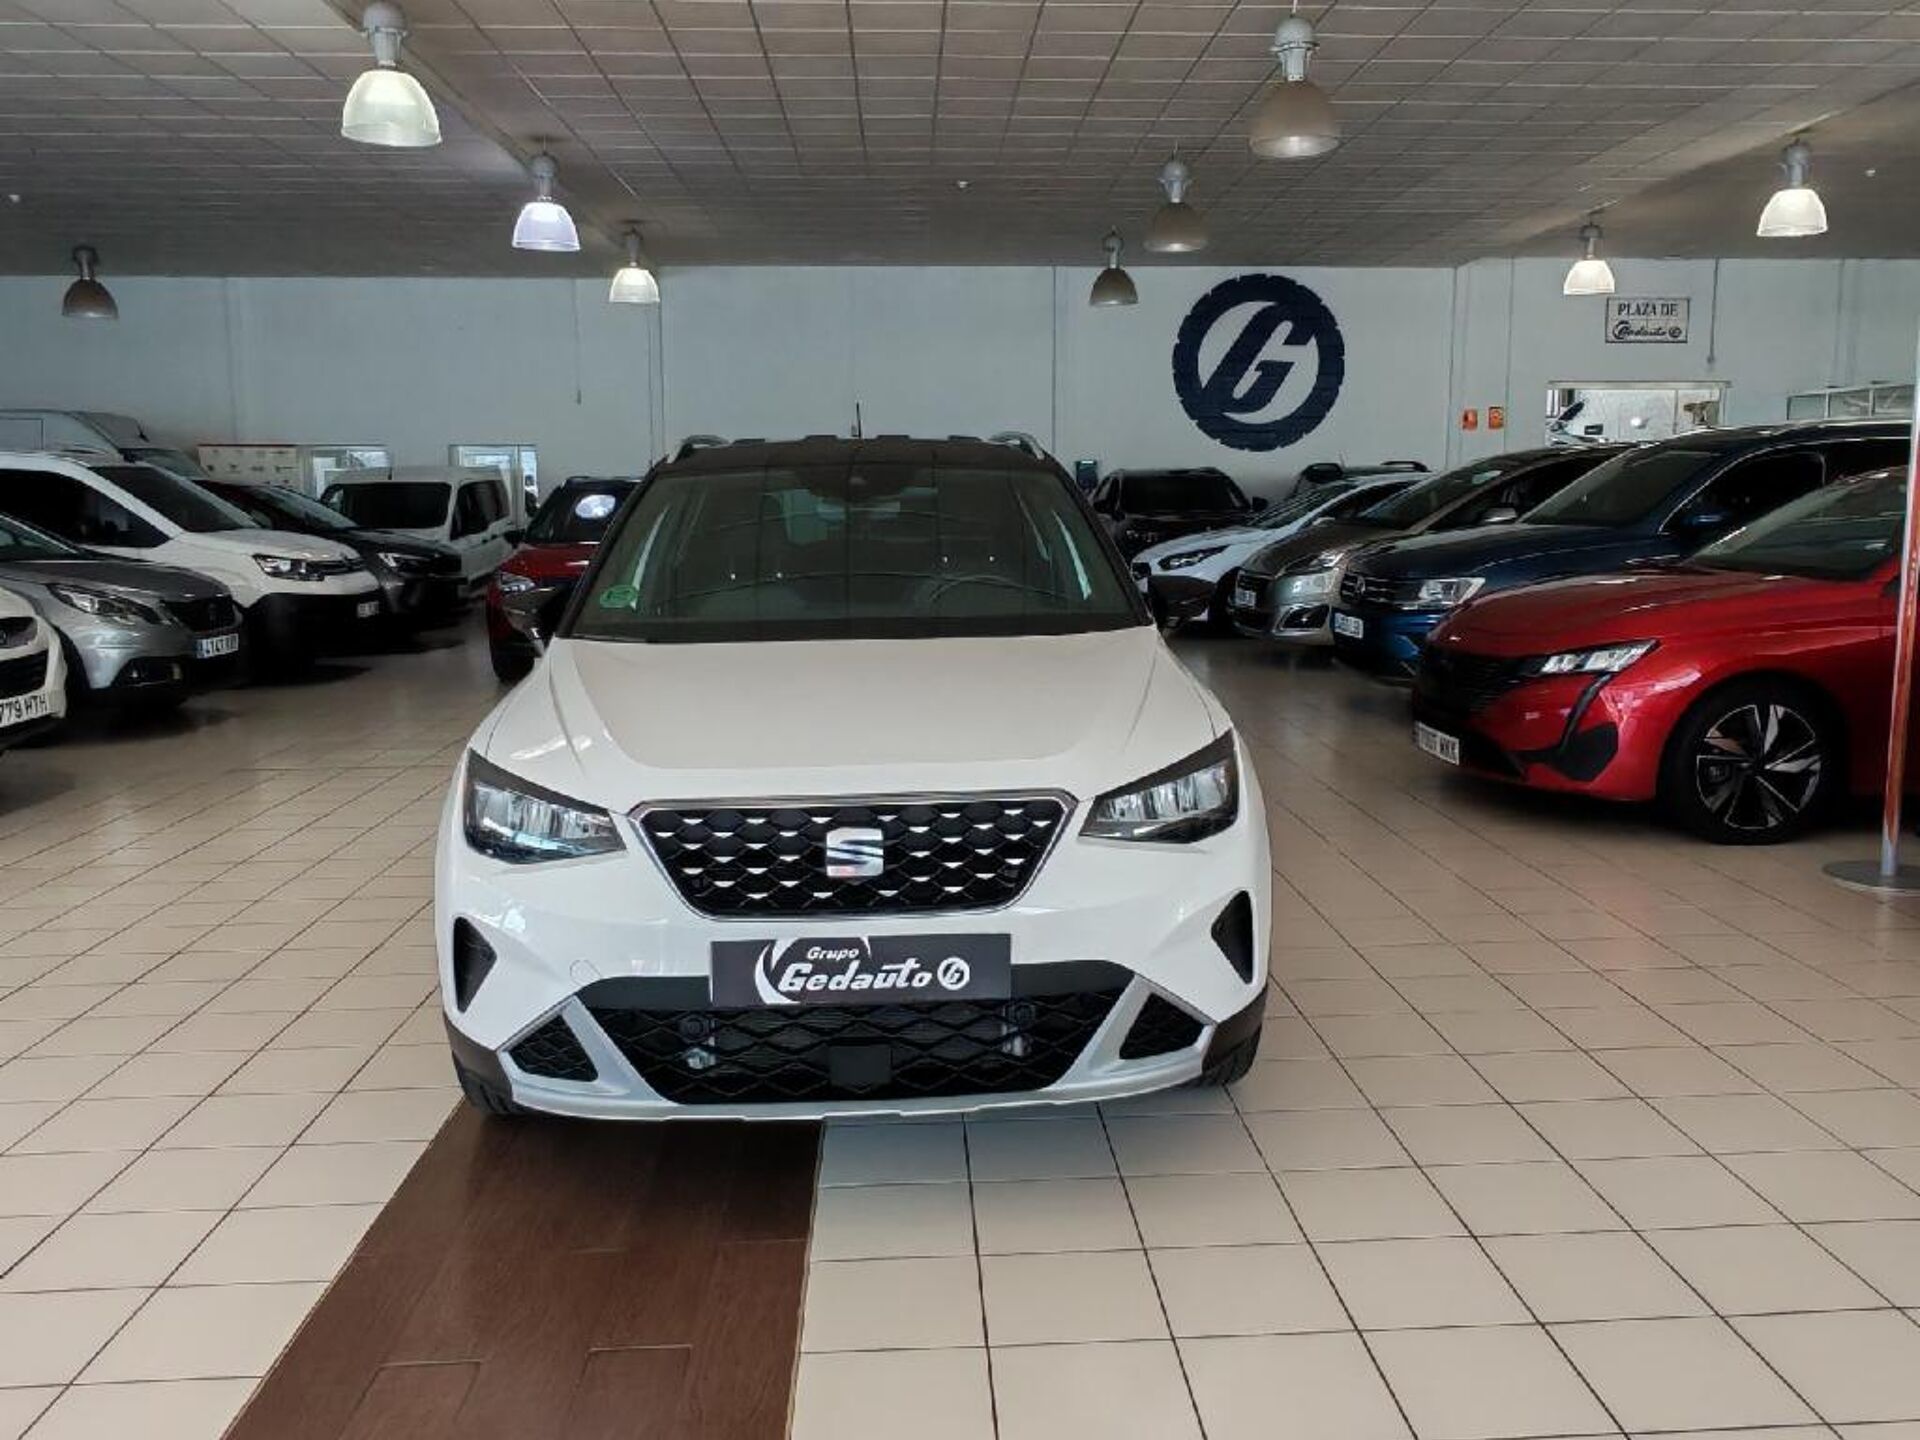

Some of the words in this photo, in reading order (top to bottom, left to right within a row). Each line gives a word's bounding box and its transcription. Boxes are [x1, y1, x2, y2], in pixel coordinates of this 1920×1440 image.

[1617, 302, 1657, 316] PLAZA
[1660, 303, 1678, 316] DE
[806, 946, 860, 961] Grupo
[778, 958, 933, 992] Gedauto
